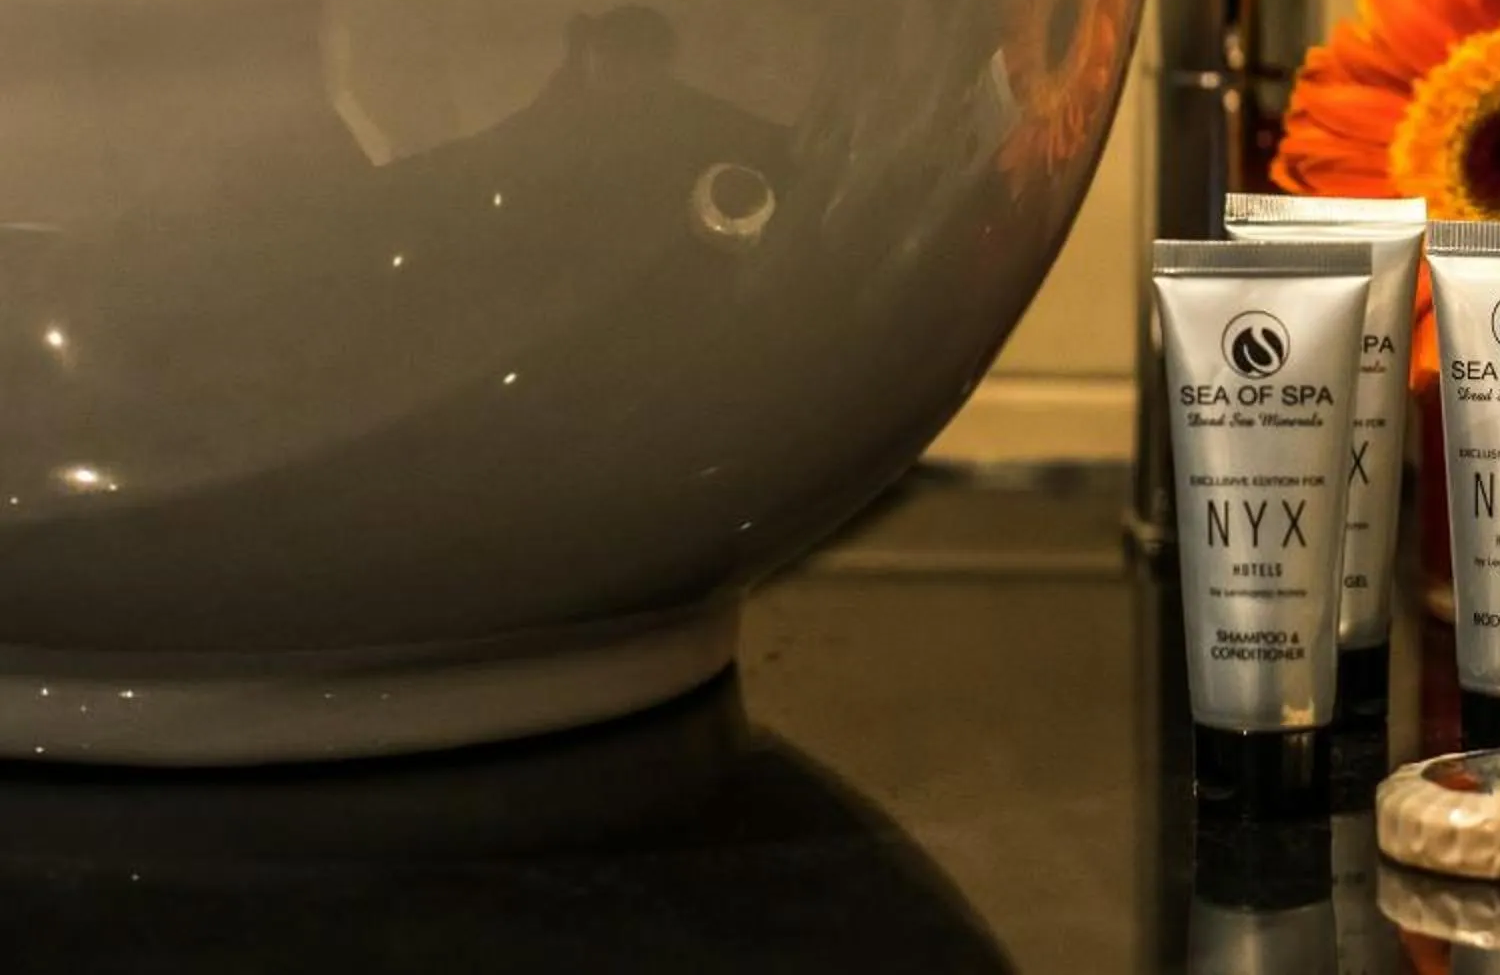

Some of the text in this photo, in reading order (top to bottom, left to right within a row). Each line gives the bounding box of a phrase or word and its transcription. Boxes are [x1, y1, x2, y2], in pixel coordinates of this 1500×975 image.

[1361, 335, 1395, 354] PA
[1451, 361, 1498, 381] SEA
[1180, 385, 1334, 406] SEA OF SPA
[1457, 387, 1492, 403] Dead
[1229, 412, 1254, 427] Sea
[1208, 500, 1306, 548] NYX
[1233, 563, 1283, 577] HOTELS
[1216, 629, 1287, 644] SHAMPOO
[1210, 645, 1305, 661] CONDITIONER
